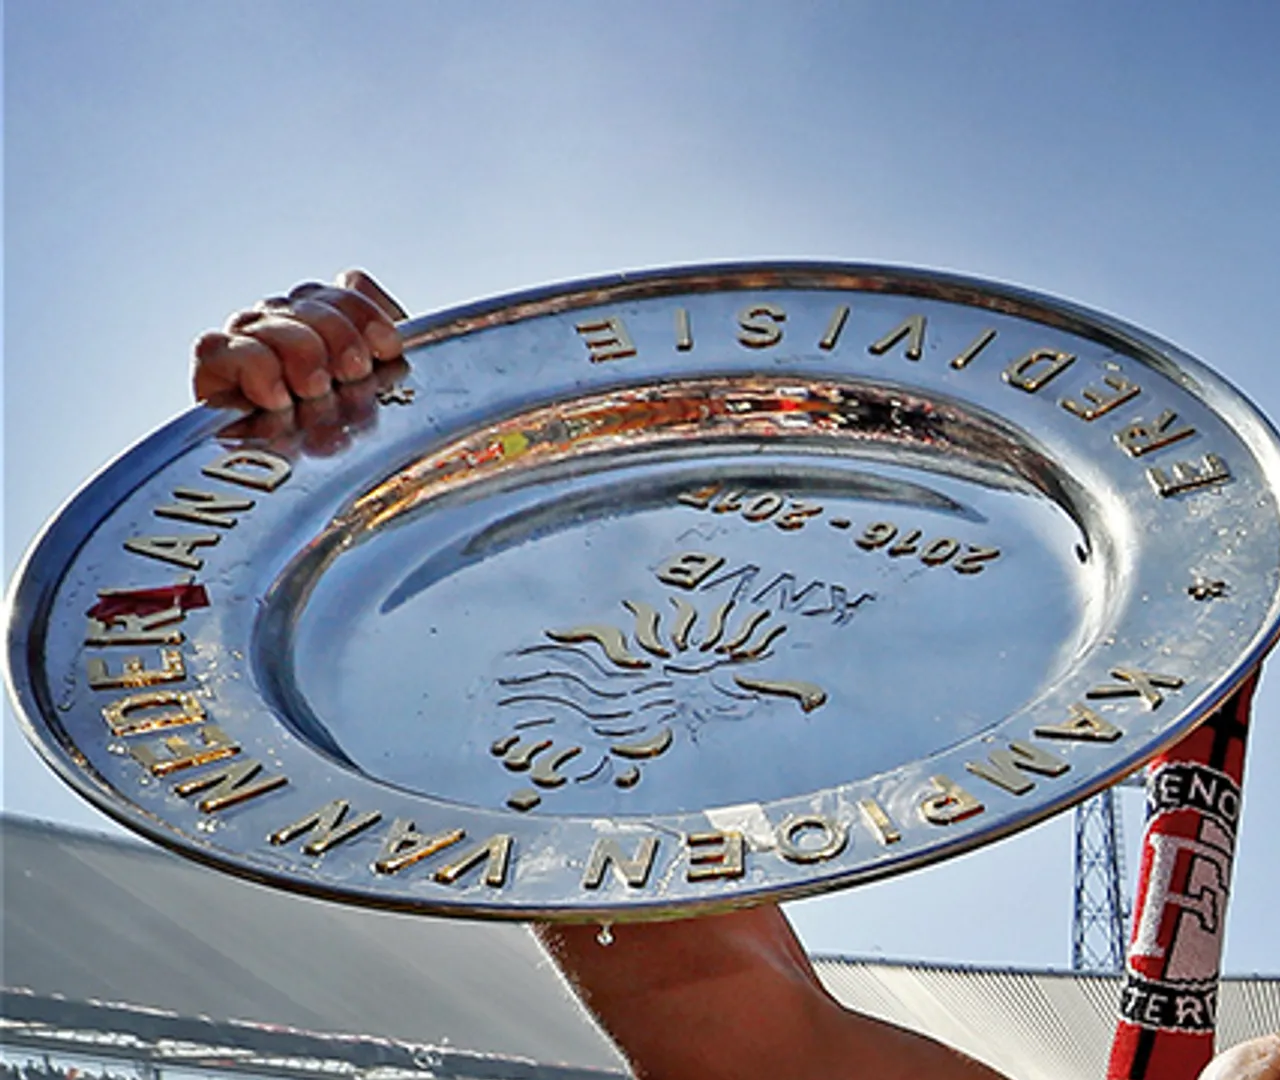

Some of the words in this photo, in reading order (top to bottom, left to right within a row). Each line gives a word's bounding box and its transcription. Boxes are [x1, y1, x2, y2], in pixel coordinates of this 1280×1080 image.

[576, 304, 1231, 499] EREDIVISIE
[84, 450, 293, 815] NEDERLAND
[658, 550, 875, 626] KNVB
[266, 800, 514, 888] VAN
[583, 664, 1184, 889] KAMPIOEN
